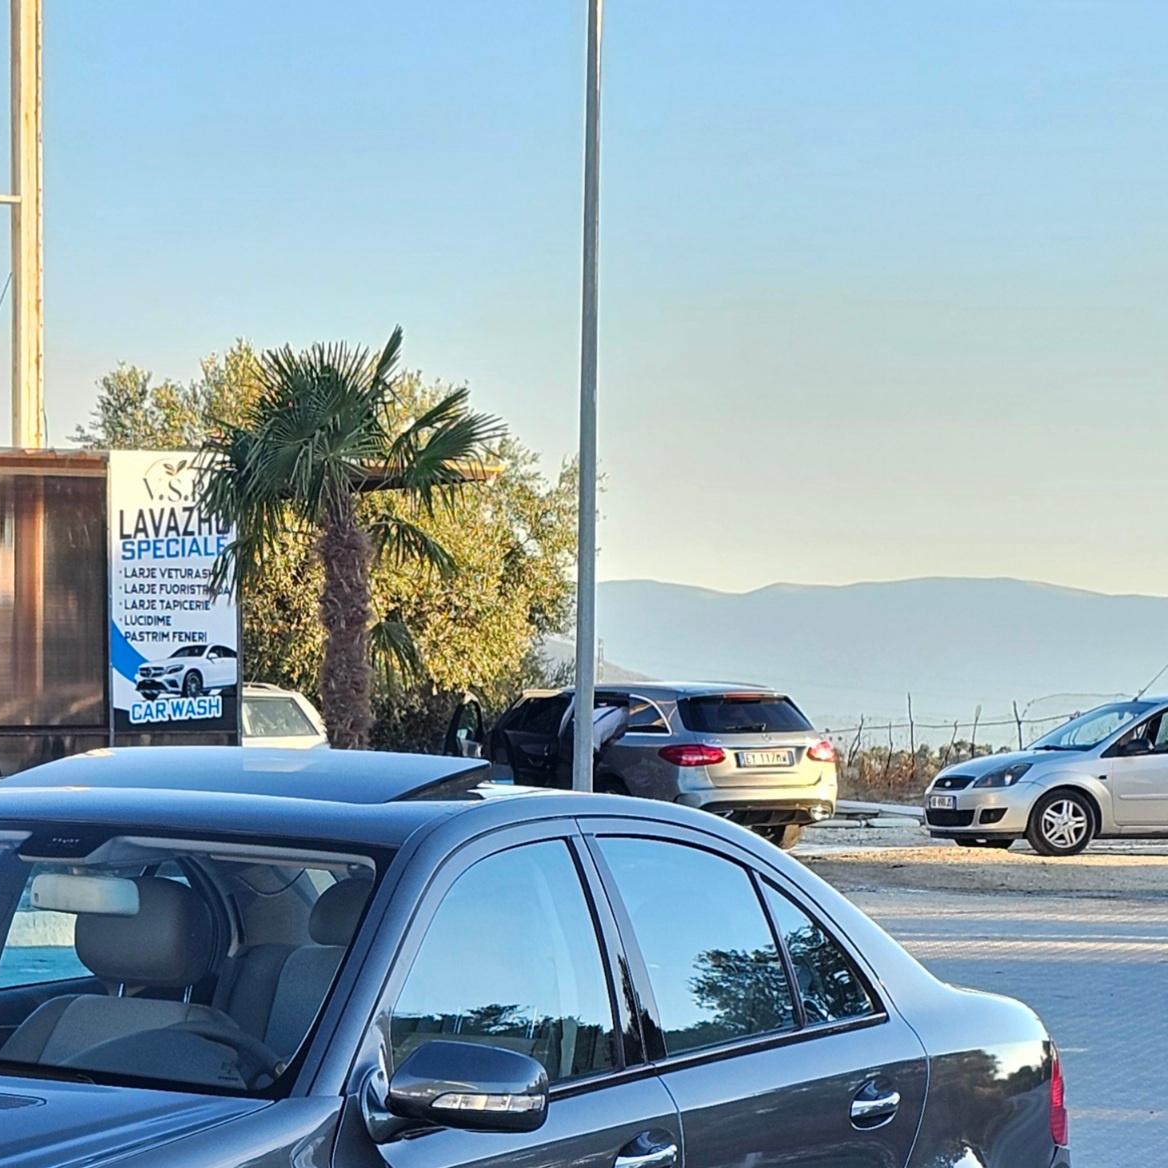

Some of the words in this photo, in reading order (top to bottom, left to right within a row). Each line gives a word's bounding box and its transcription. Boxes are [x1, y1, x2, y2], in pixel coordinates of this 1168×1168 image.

[121, 536, 228, 560] SPECIALE
[124, 567, 157, 579] LARJE
[124, 583, 157, 595] LARJE
[159, 583, 231, 595] FUORISTRDA
[124, 599, 157, 611] LARJE
[159, 599, 211, 611] TAPICERIE
[124, 615, 172, 626] LUCIDIME
[124, 631, 170, 642] PASTRIM
[172, 631, 208, 642] FENERI
[131, 702, 167, 721] CAR
[170, 698, 220, 718] WASH
